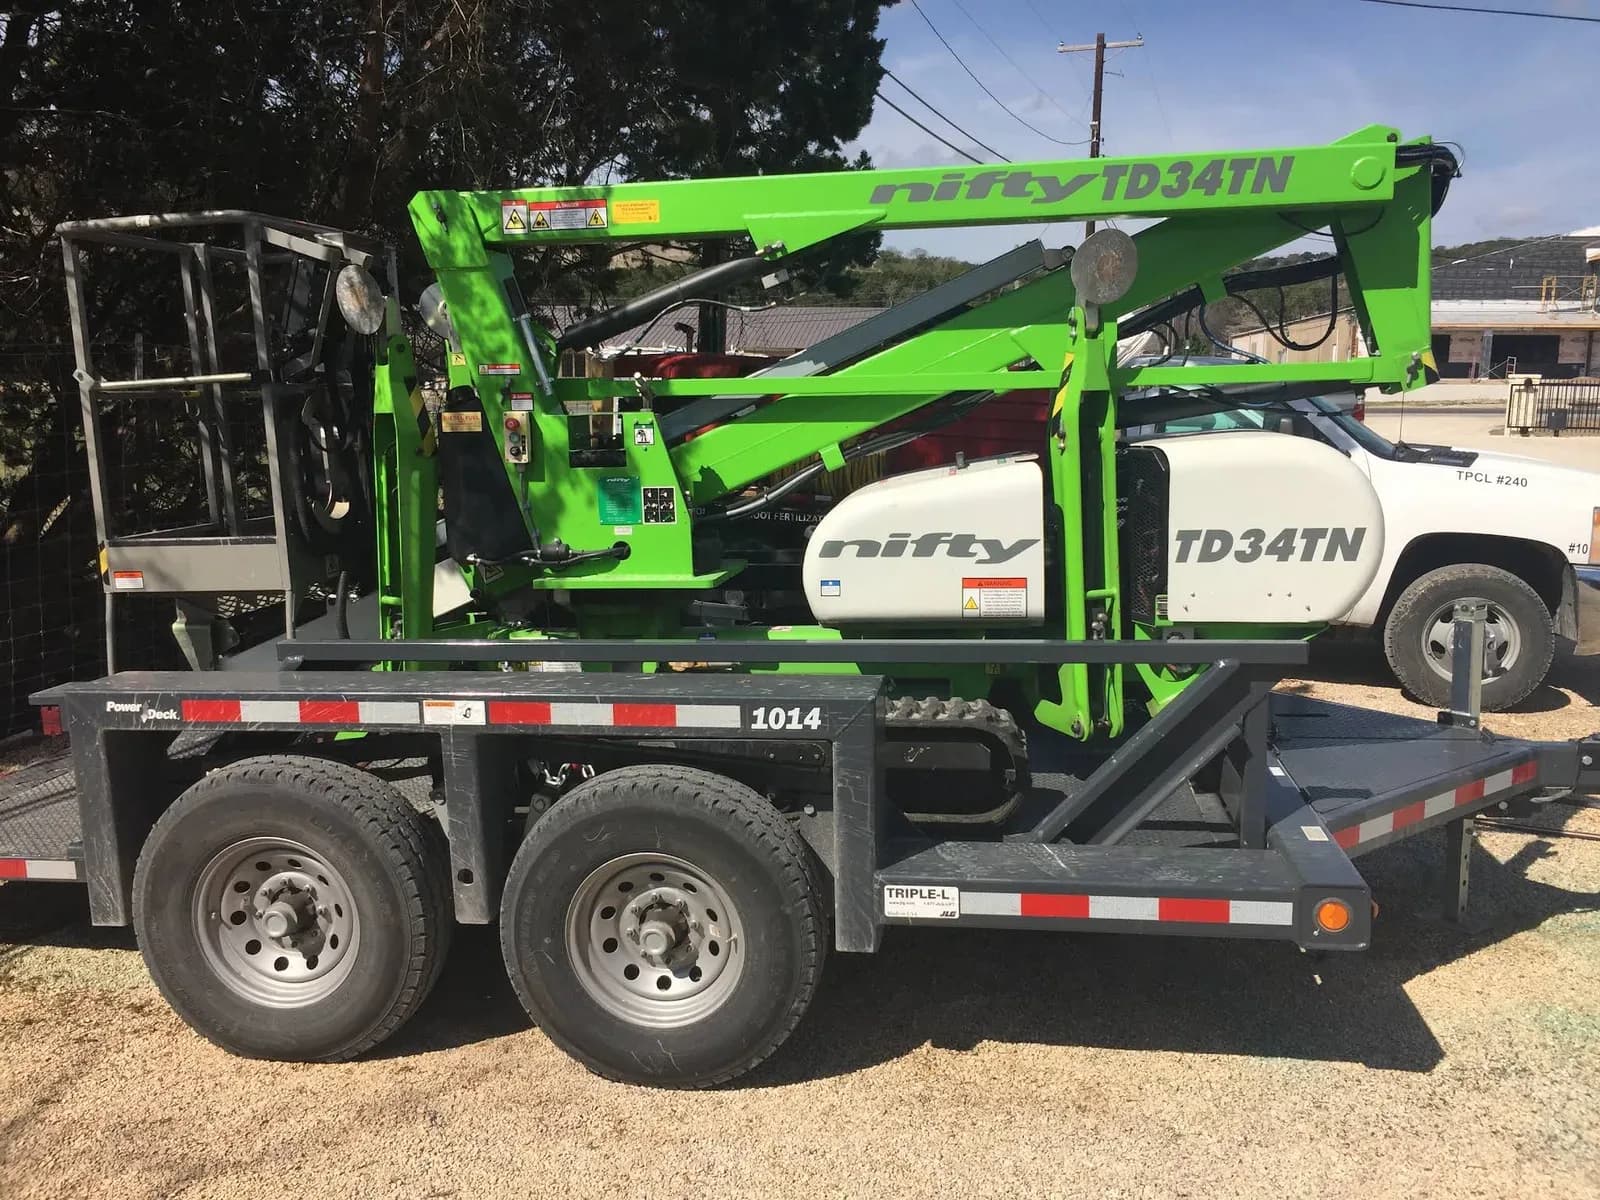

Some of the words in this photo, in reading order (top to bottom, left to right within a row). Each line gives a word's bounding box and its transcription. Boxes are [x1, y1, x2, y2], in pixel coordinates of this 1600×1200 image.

[870, 170, 1101, 204] nifty
[1100, 155, 1295, 200] TD34TN
[1456, 470, 1492, 483] TPCL
[1496, 475, 1528, 487] #240
[774, 512, 825, 523] FERTILIZAT
[818, 532, 1041, 564] nifty
[1175, 527, 1367, 563] TD34TN
[1568, 543, 1589, 554] #10
[106, 701, 142, 712] Power
[751, 707, 822, 730] 1014
[886, 887, 950, 900] TRIPLE-L
